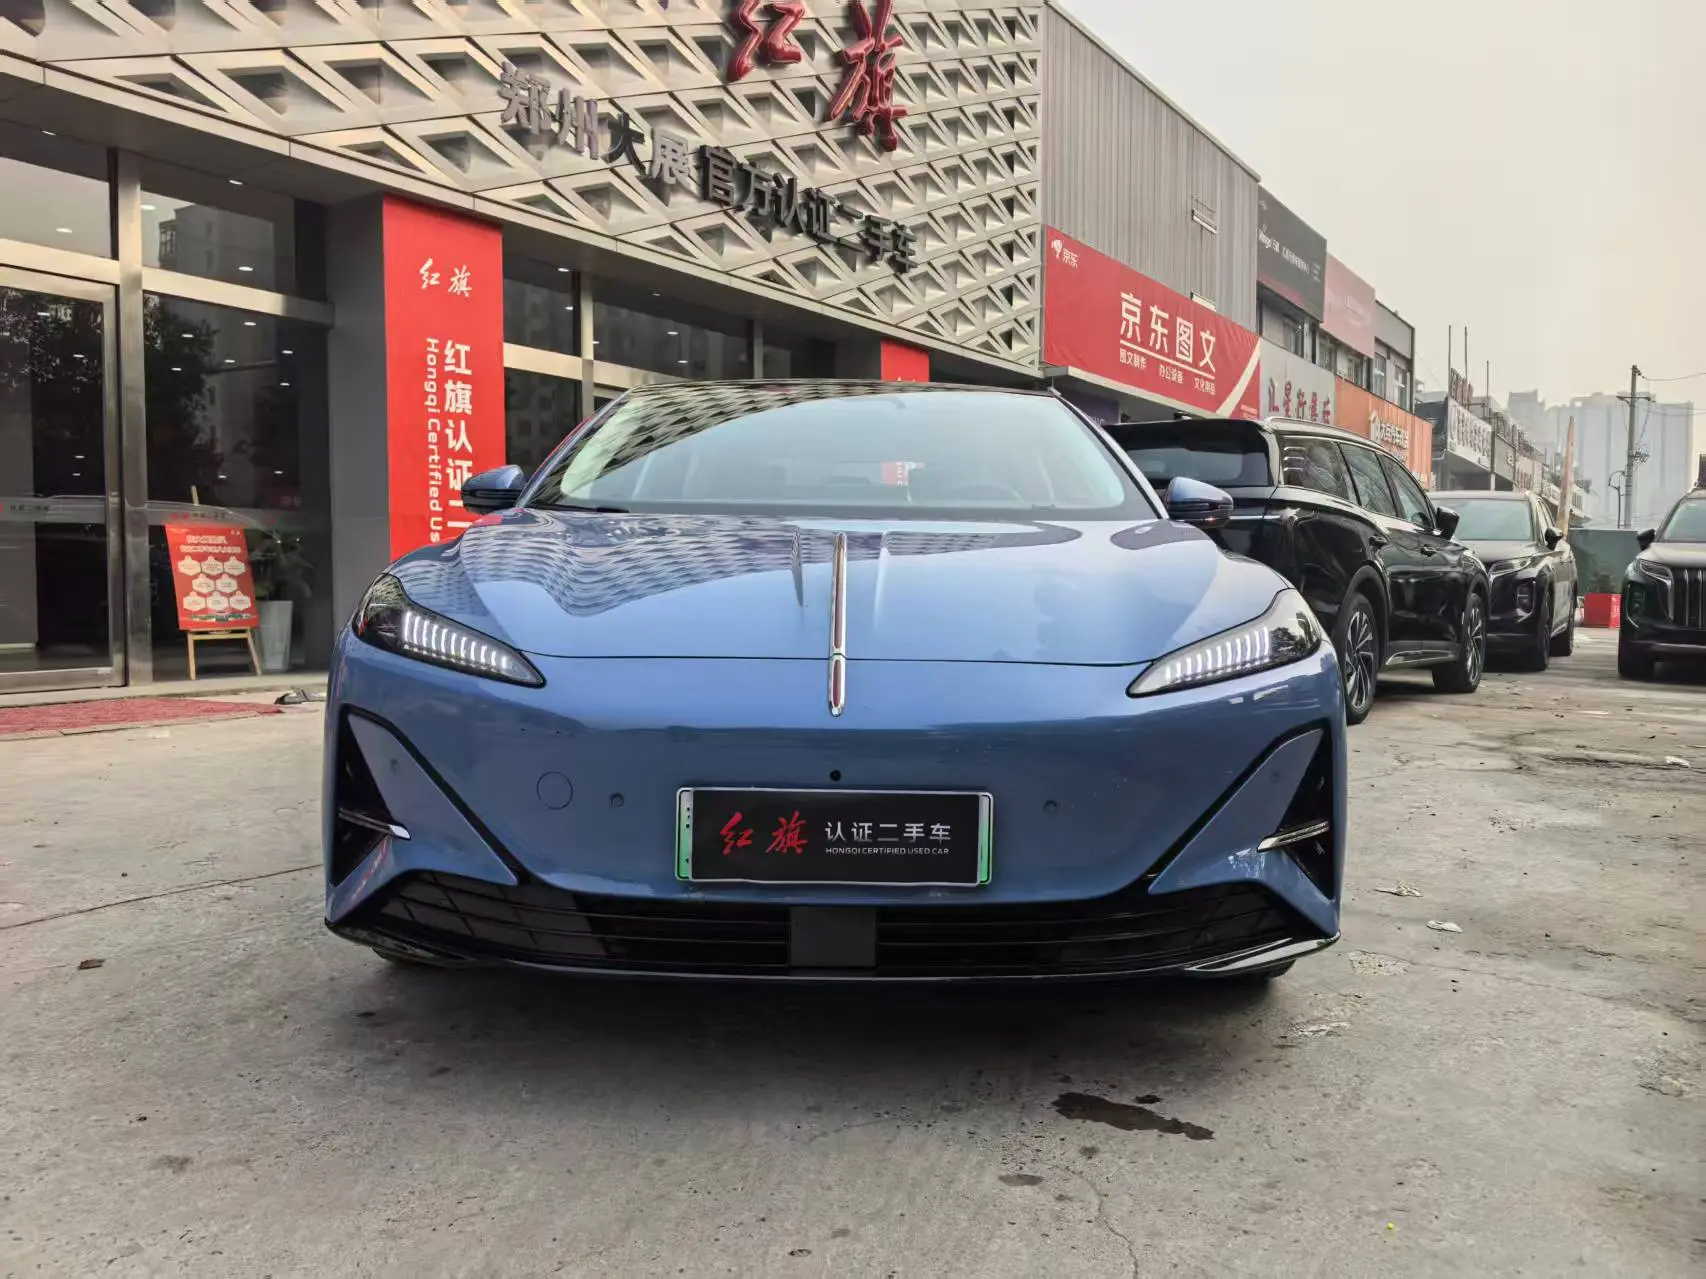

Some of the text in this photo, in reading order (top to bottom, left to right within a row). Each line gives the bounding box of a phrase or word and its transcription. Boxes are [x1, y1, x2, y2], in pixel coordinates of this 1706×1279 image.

[419, 258, 473, 297] 红旗
[1062, 248, 1082, 269] 京东
[1119, 291, 1217, 373] 京东图文
[424, 338, 440, 412] Hongqi
[427, 419, 444, 511] Certified
[719, 810, 951, 855] 红旗 认证二手车
[825, 847, 950, 855] HONGQI CERTIFIED USED CAR
